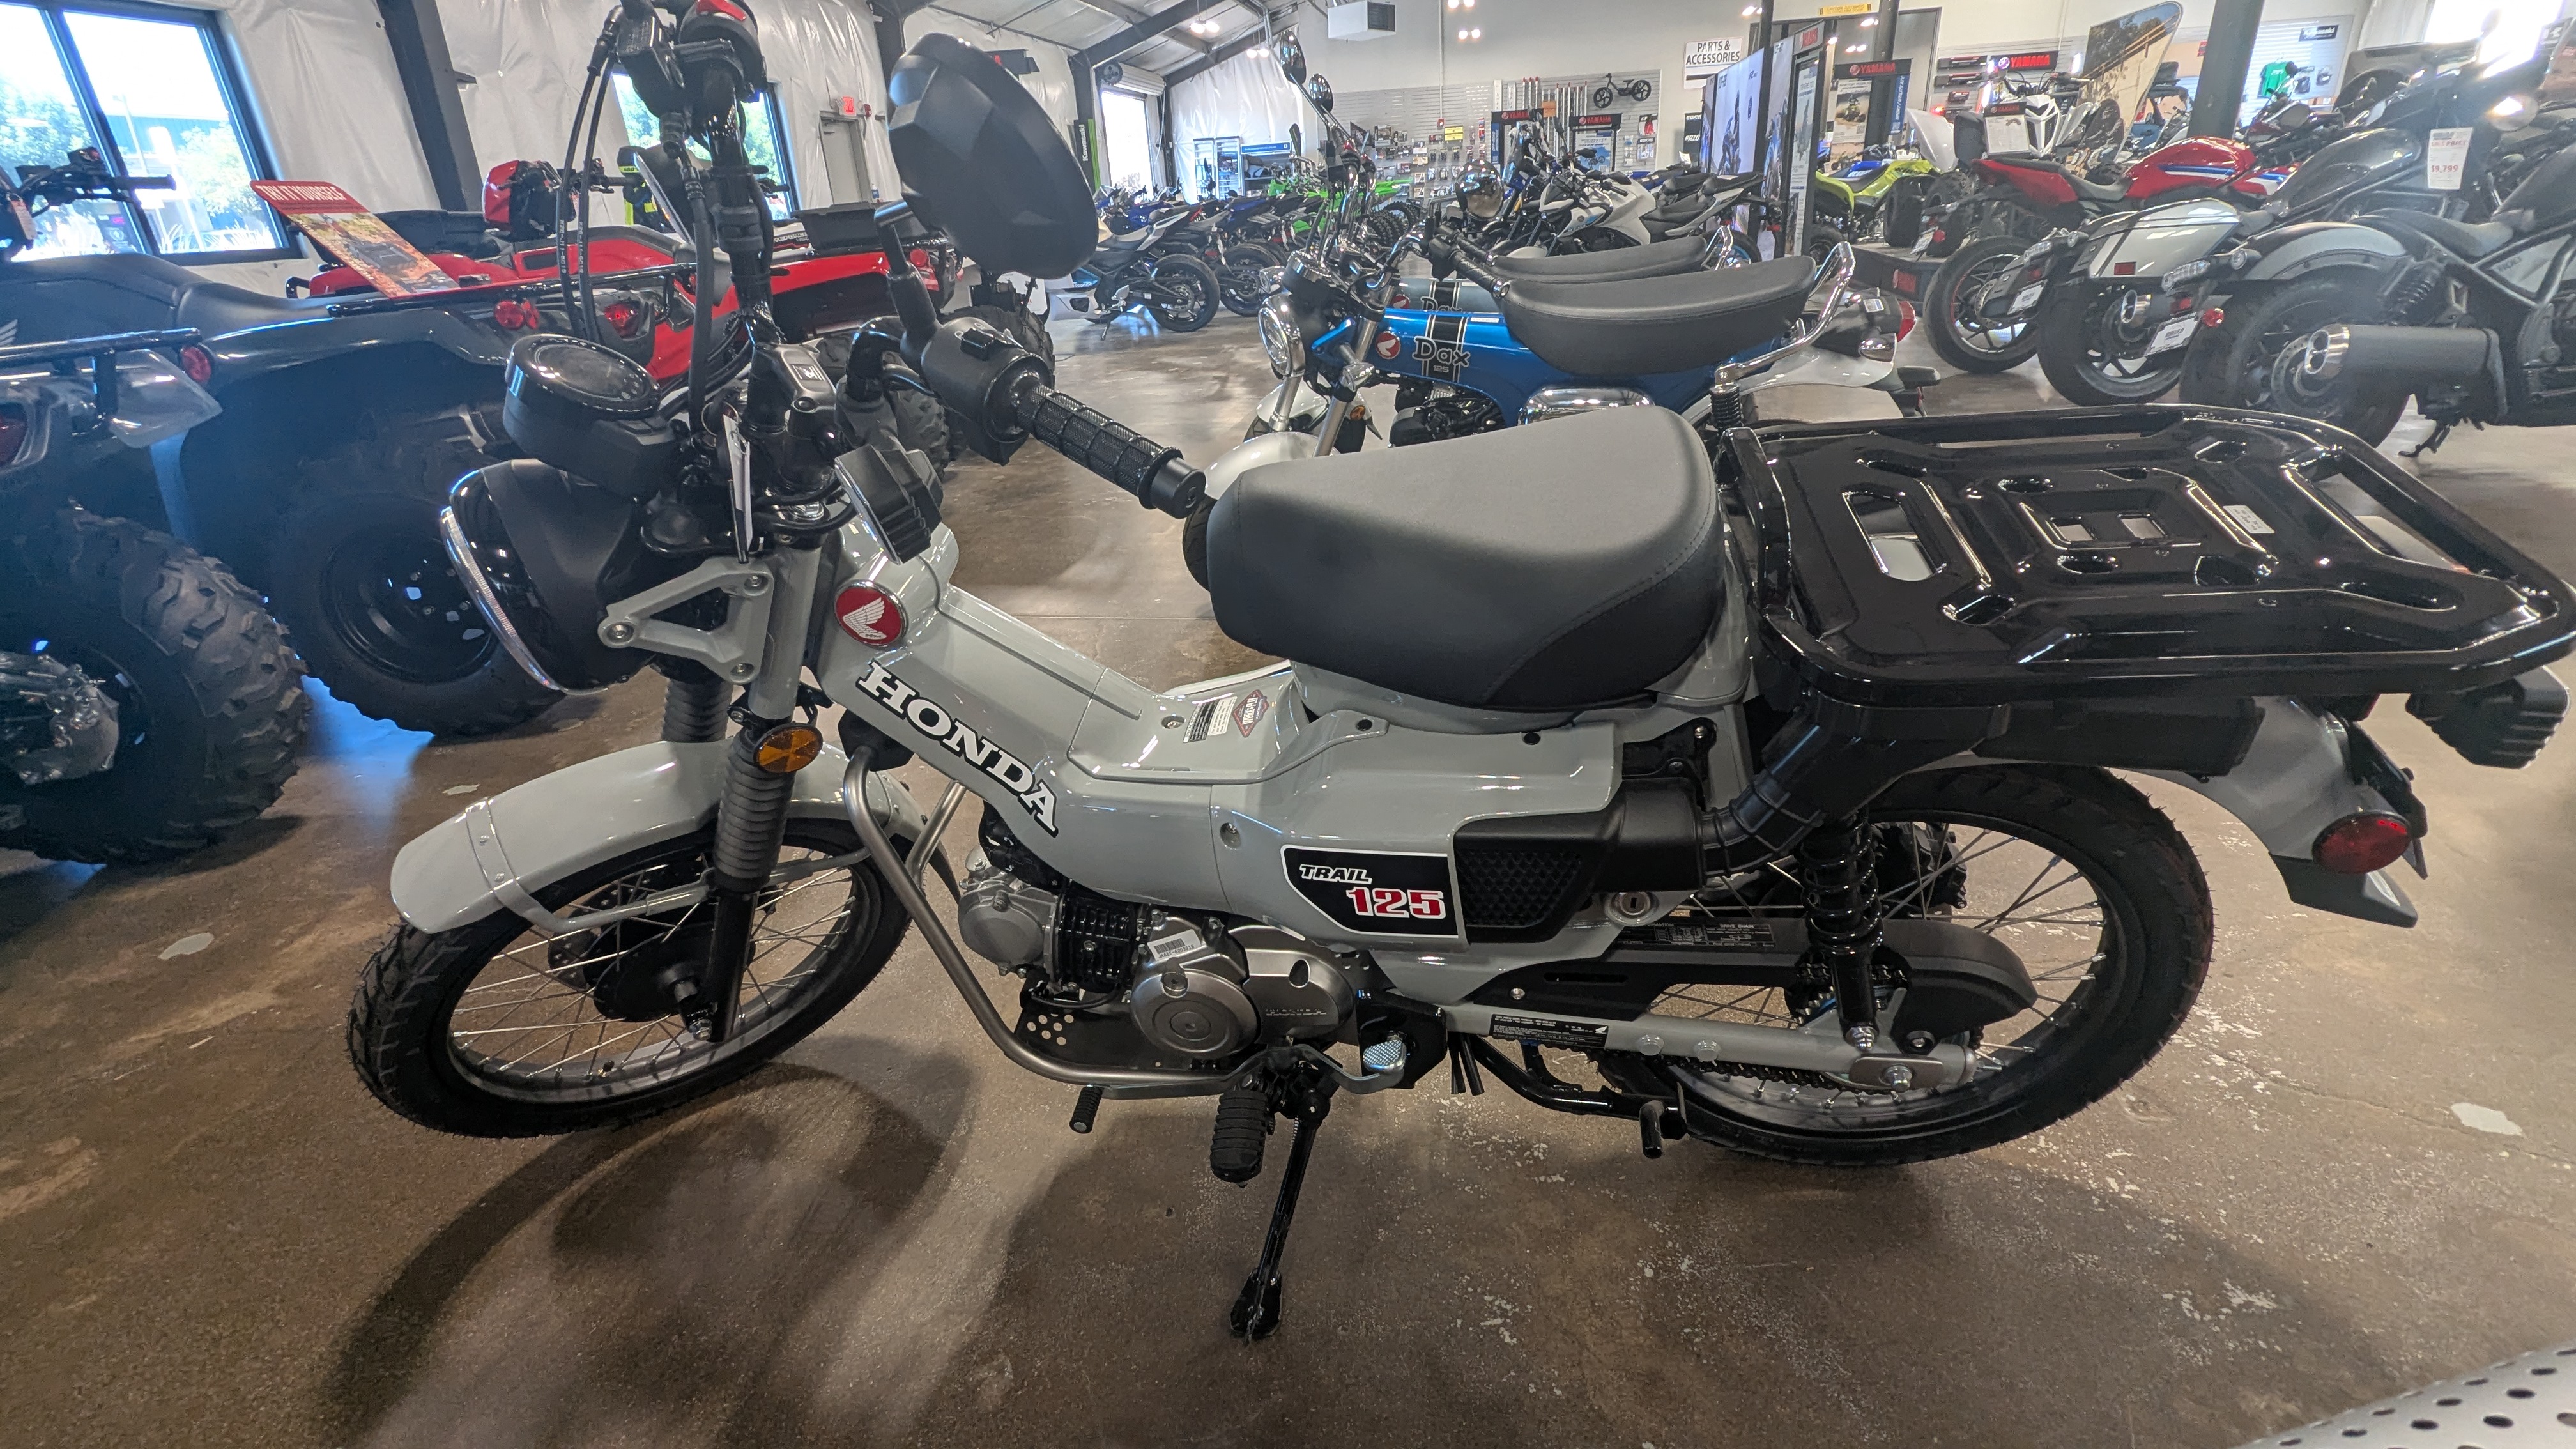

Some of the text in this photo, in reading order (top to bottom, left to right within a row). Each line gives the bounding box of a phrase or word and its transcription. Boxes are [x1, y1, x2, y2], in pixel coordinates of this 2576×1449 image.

[1697, 40, 1731, 52] PARTS &
[1686, 51, 1740, 65] ACCESSORIES
[2011, 54, 2050, 68] YAMAHA
[1860, 63, 1896, 73] YAMAHA
[1586, 116, 1612, 124] YAMAHA
[1078, 123, 1089, 162] Kawasaki
[256, 185, 289, 201] TRY
[288, 185, 347, 201] YOURSELF
[1412, 336, 1471, 367] Dax
[1433, 365, 1450, 373] 125
[855, 659, 1059, 838] HONDA
[1300, 864, 1372, 885] TRAIL
[1346, 886, 1446, 919] 125
